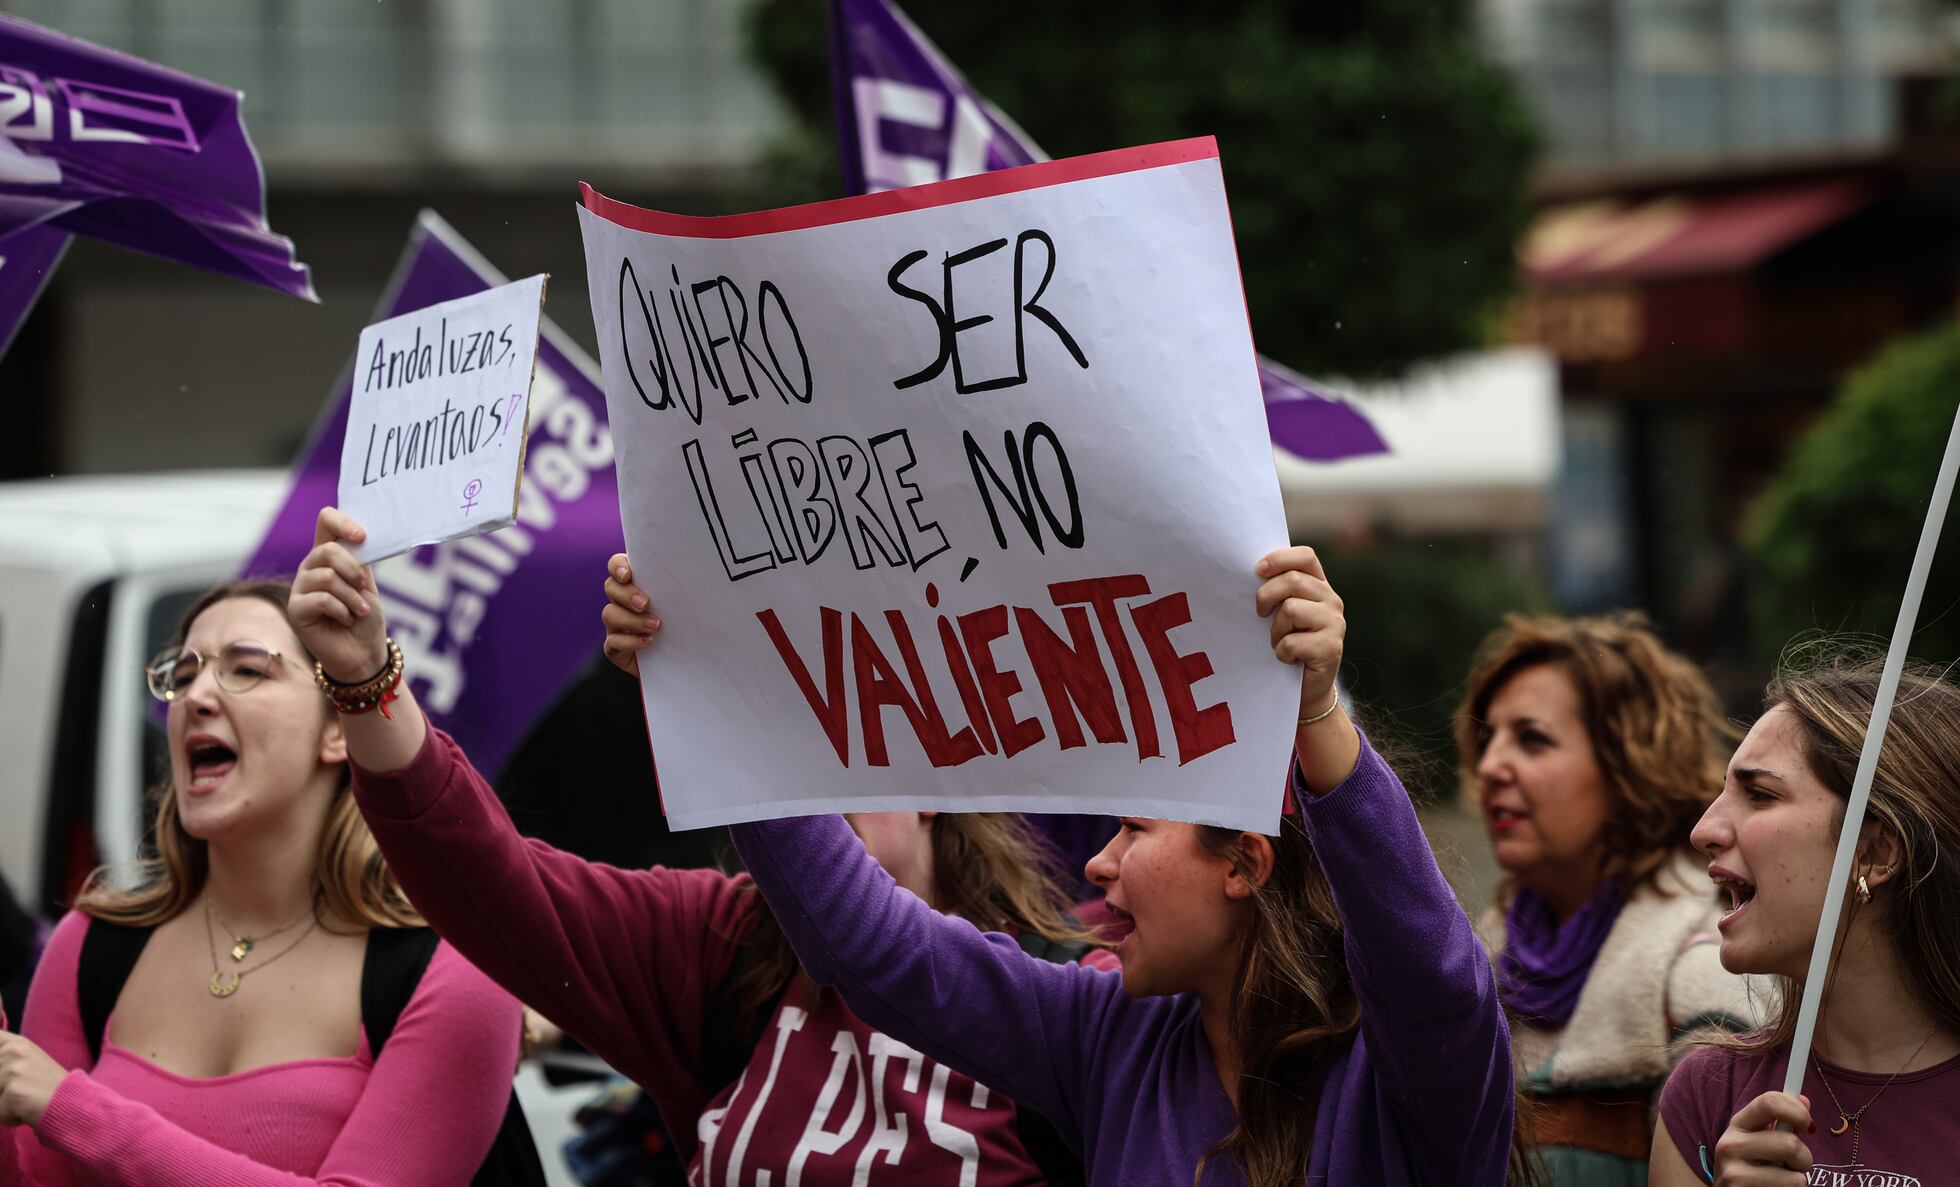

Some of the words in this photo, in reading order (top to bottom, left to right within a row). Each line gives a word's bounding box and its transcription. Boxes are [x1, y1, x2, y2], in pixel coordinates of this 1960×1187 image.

[365, 317, 517, 393] Andaluzas,
[887, 228, 1090, 396] SER
[361, 393, 523, 487] Levantaos!
[962, 421, 1086, 556] NO
[756, 574, 1237, 768] VALIENTE
